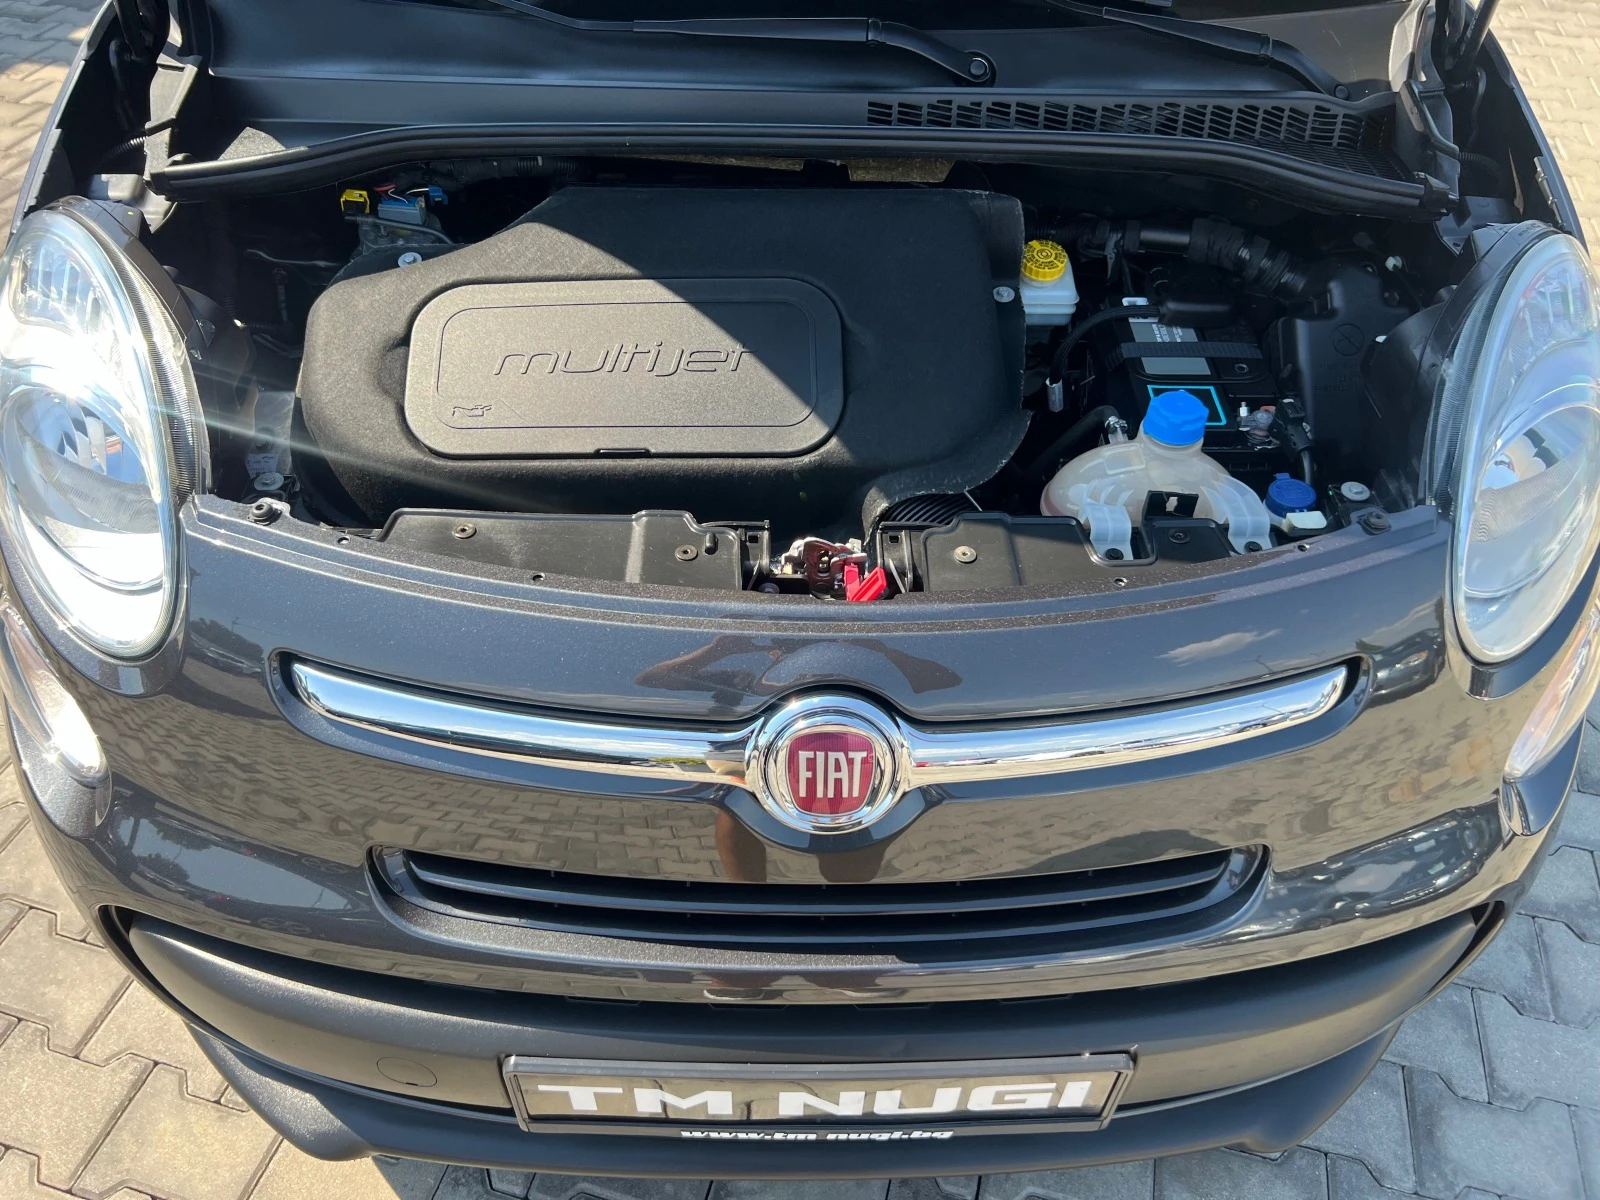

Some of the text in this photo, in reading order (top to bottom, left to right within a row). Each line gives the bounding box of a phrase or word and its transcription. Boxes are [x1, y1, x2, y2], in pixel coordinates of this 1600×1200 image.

[493, 340, 755, 378] multijet
[798, 750, 868, 799] FIAT
[537, 1080, 1092, 1117] TM NUGI
